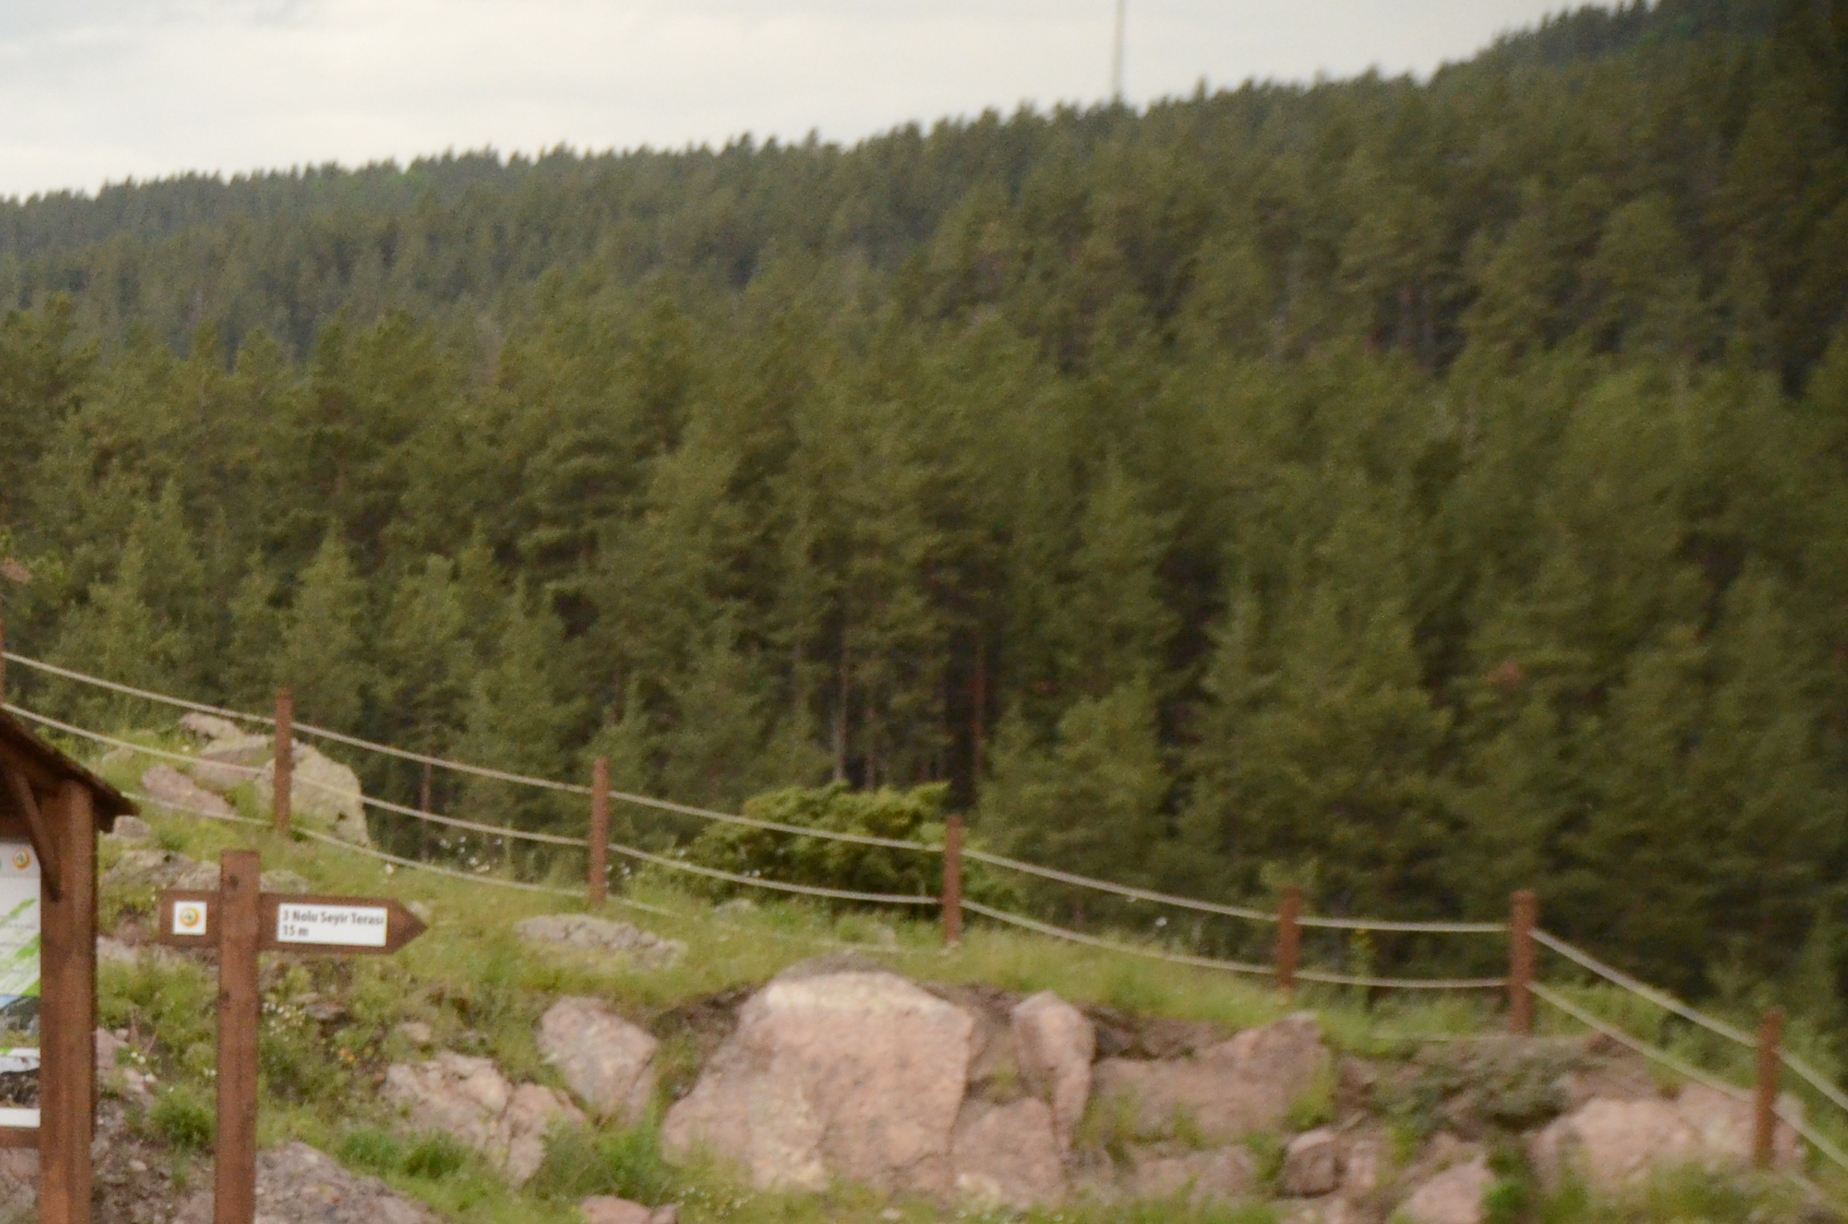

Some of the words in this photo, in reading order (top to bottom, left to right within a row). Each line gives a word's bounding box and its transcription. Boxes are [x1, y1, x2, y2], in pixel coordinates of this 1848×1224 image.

[284, 910, 289, 920] 3
[293, 911, 318, 922] Nolu
[321, 912, 348, 925] Seyir
[283, 925, 294, 935] 15
[299, 928, 309, 936] m
